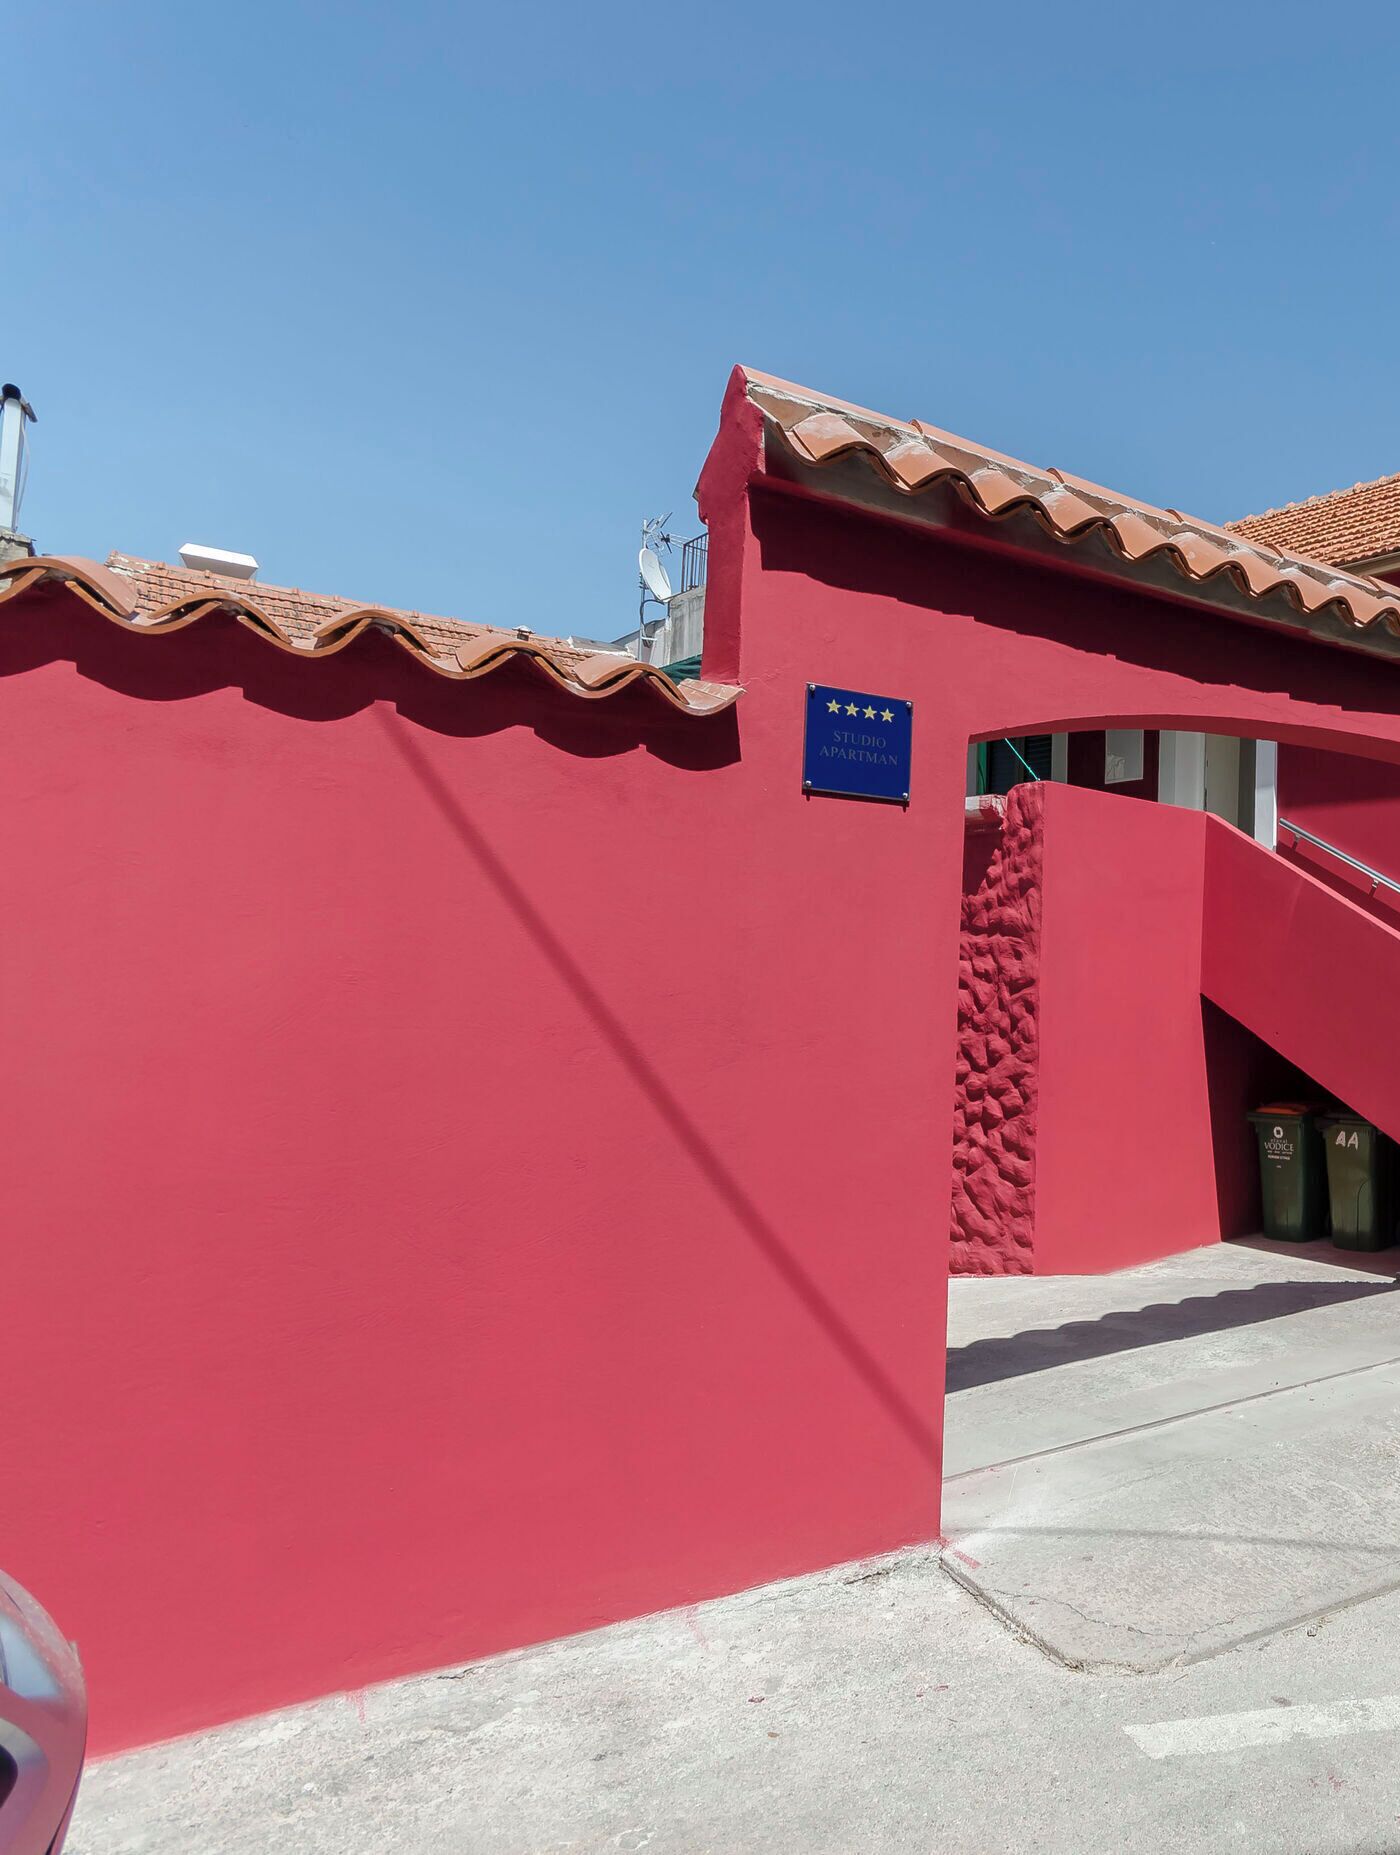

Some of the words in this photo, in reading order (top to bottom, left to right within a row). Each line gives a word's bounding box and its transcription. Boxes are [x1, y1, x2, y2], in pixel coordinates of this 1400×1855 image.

[833, 730, 886, 748] STUDIO
[819, 745, 898, 766] APARTMAN
[1264, 1142, 1294, 1152] VODICE
